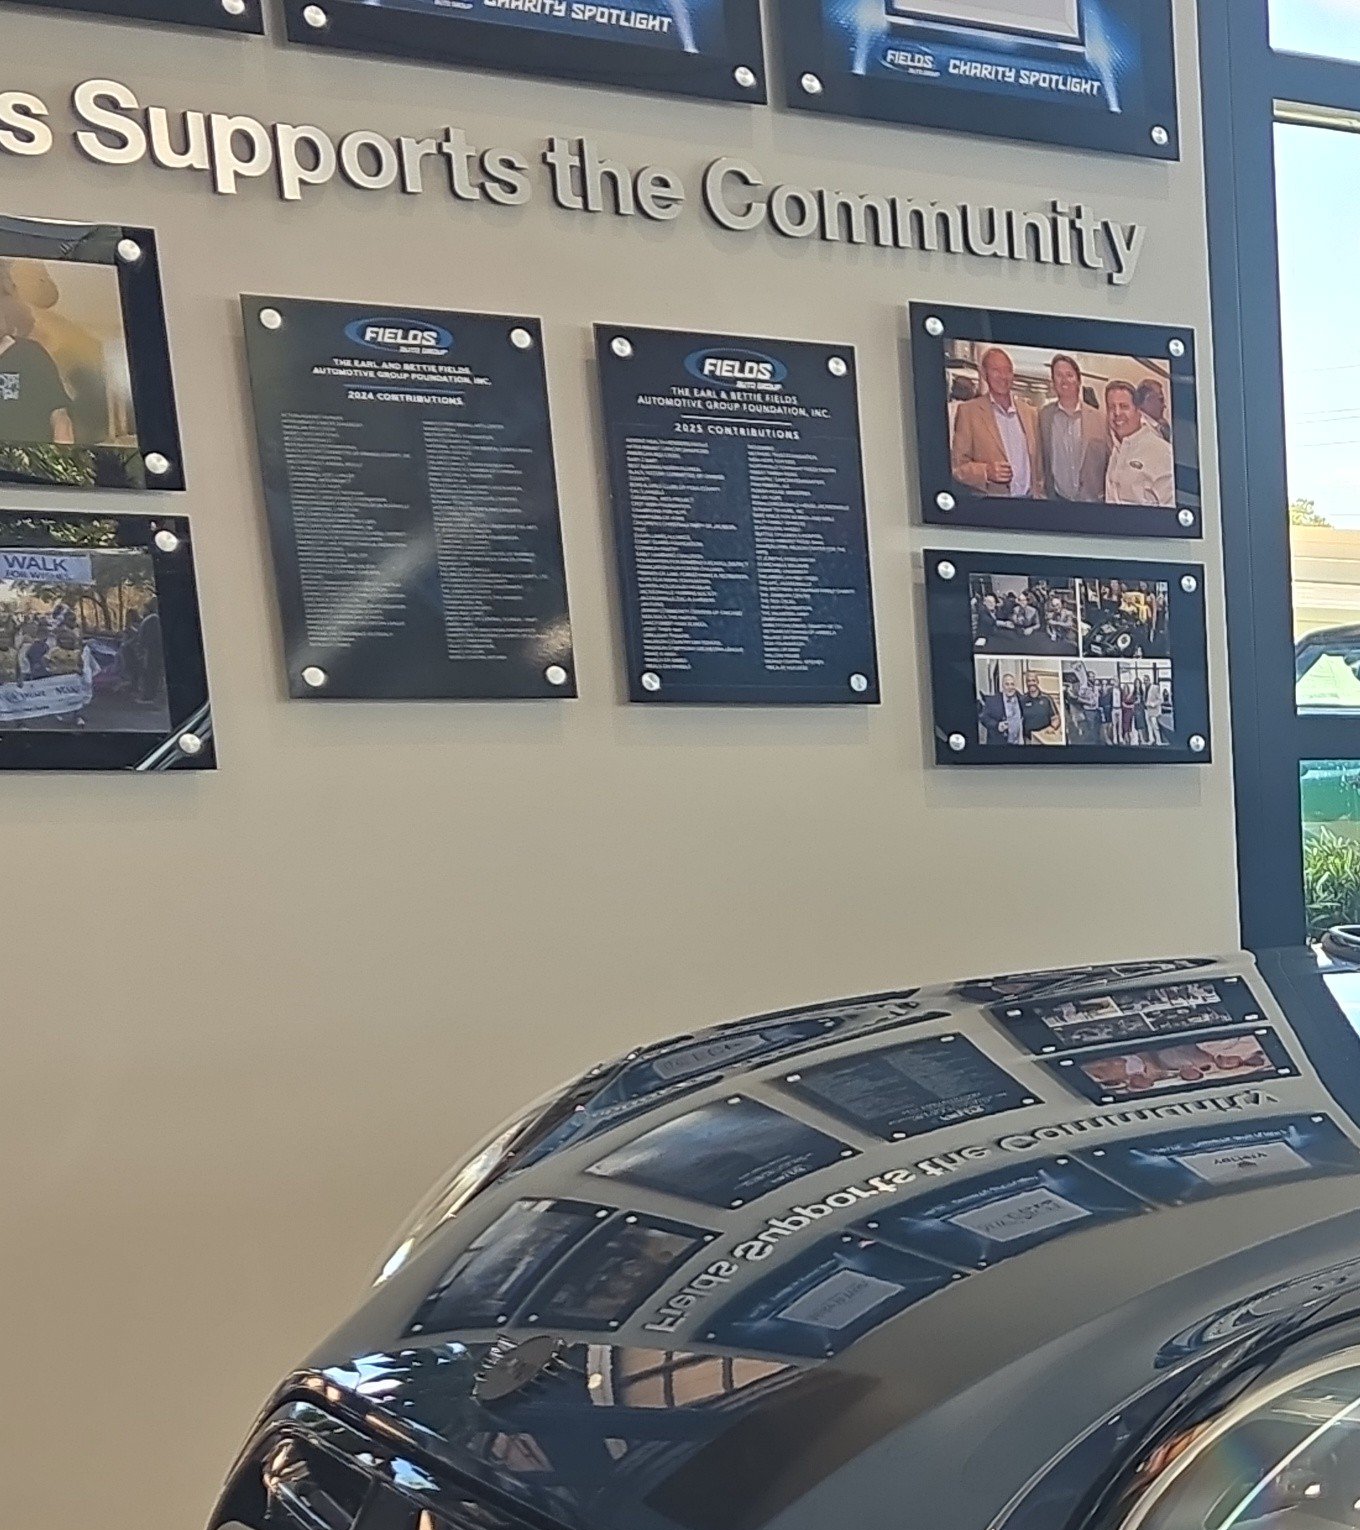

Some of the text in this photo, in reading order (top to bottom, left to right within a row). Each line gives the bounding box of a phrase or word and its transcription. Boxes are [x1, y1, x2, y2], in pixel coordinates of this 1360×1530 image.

[571, 3, 673, 33] SPOTLIGHT
[886, 49, 934, 69] FIELDS
[948, 58, 1101, 96] CHARITY SPOTLIGHT
[72, 78, 533, 207] Supports
[542, 136, 685, 221] the
[703, 156, 1146, 286] Community
[364, 326, 438, 346] FIELDS
[312, 366, 376, 379] AUTOMOTIVE
[377, 370, 409, 380] GROUP
[332, 358, 353, 367] THE
[354, 359, 378, 369] EARL
[381, 361, 401, 370] AND
[439, 365, 472, 375] FIELDS
[702, 358, 774, 380] FIELDS
[376, 392, 464, 406] CONTRIBUTIONS
[670, 386, 690, 397] THE
[693, 388, 717, 399] EARL
[731, 392, 763, 403] BETTIE
[765, 394, 798, 406] FIELDS
[637, 395, 704, 409] AUTOMOTIVE
[705, 399, 740, 411] GROUP
[811, 407, 831, 419] INC.
[674, 422, 801, 441] 2025 CONTRIBUTIONS
[3, 554, 68, 572] WALK
